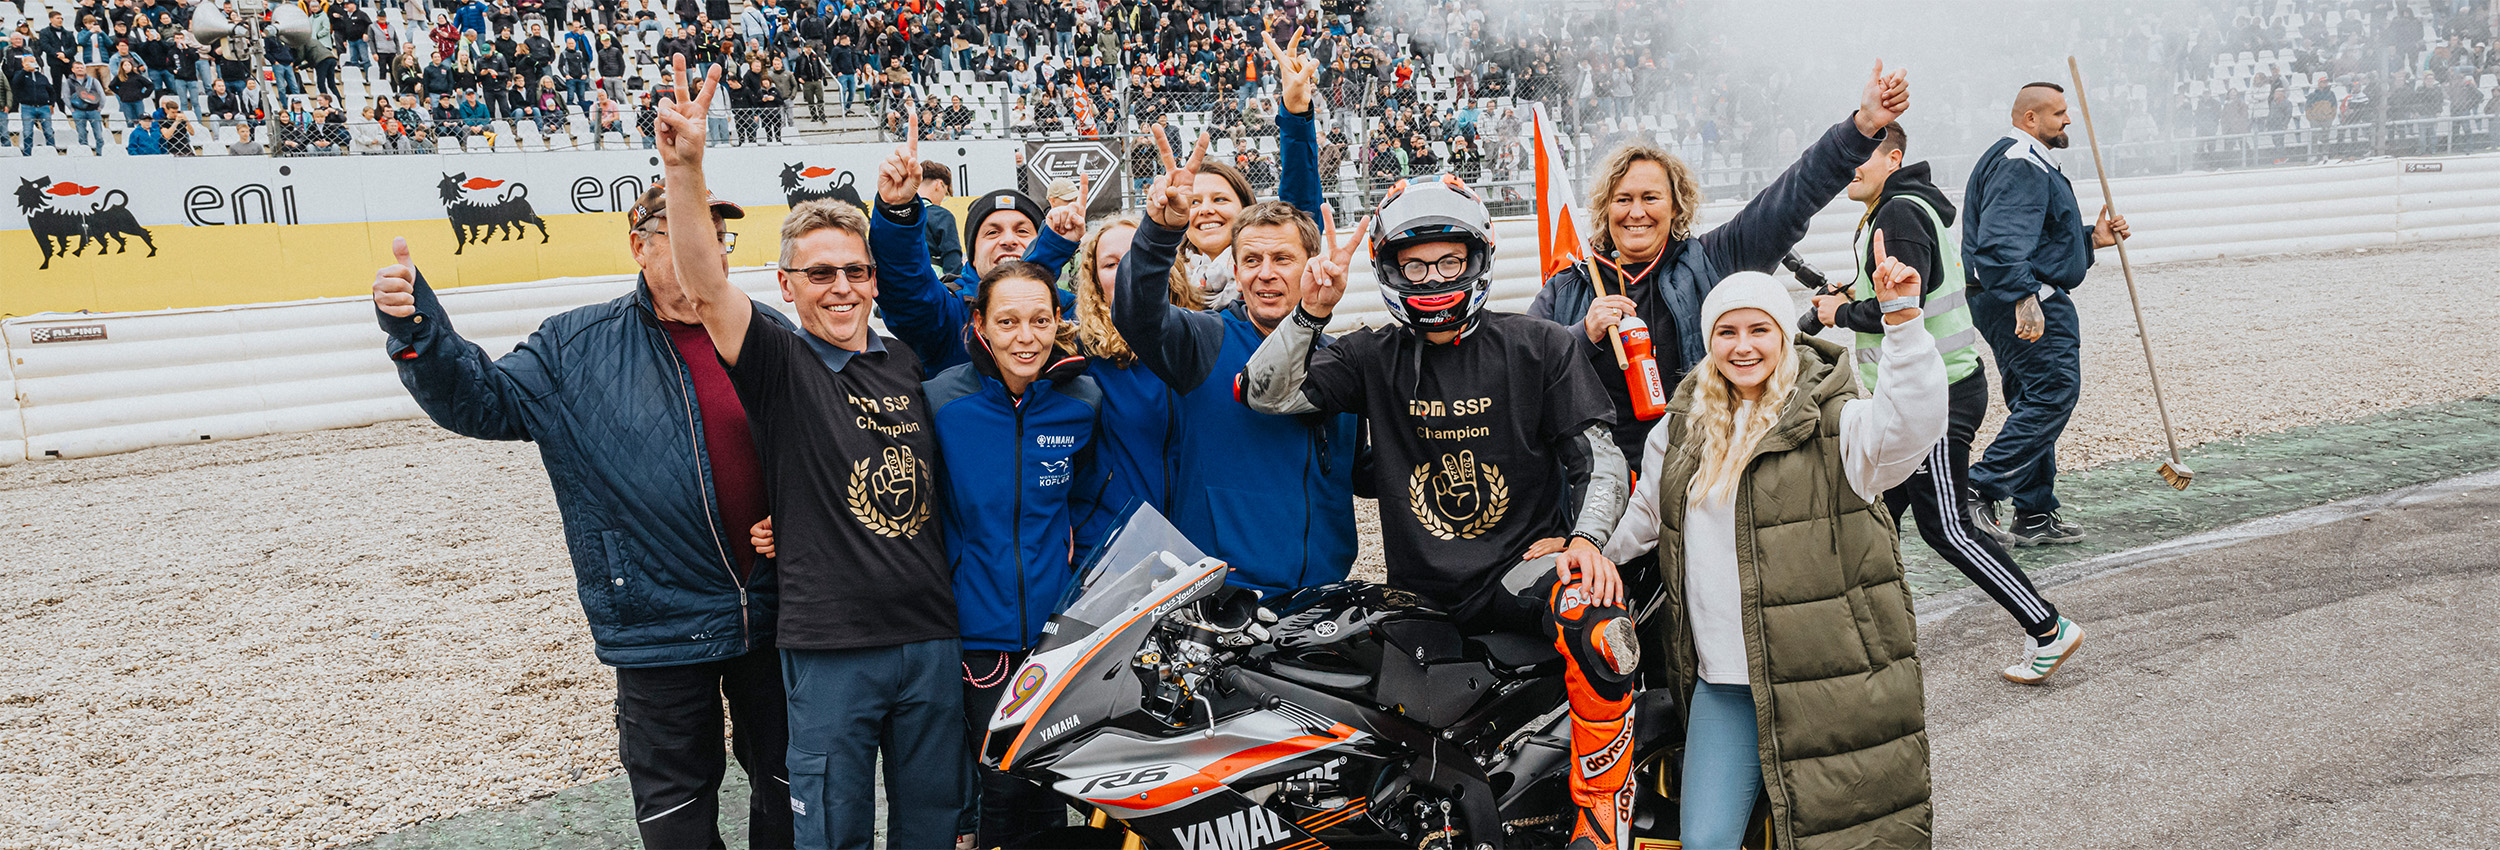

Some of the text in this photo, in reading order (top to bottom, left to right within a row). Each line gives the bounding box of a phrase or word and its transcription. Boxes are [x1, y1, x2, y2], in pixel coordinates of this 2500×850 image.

[183, 165, 299, 226] eni
[52, 327, 102, 337] ALPINA
[1648, 367, 1660, 398] Grapos
[882, 395, 910, 412] SSP
[1452, 397, 1492, 416] SSP
[855, 415, 920, 438] Chmpion
[1416, 425, 1490, 441] Champion
[1046, 435, 1074, 444] YAMAHA
[888, 453, 900, 476] 2024
[905, 451, 913, 474] 2025
[1446, 459, 1460, 481] 2024
[1463, 457, 1473, 479] 2025
[1147, 573, 1216, 622] Revs Your Heart
[1000, 662, 1048, 720] 9
[1039, 714, 1081, 742] YAMAHA
[1585, 716, 1634, 772] daytona
[1079, 765, 1172, 794] R6
